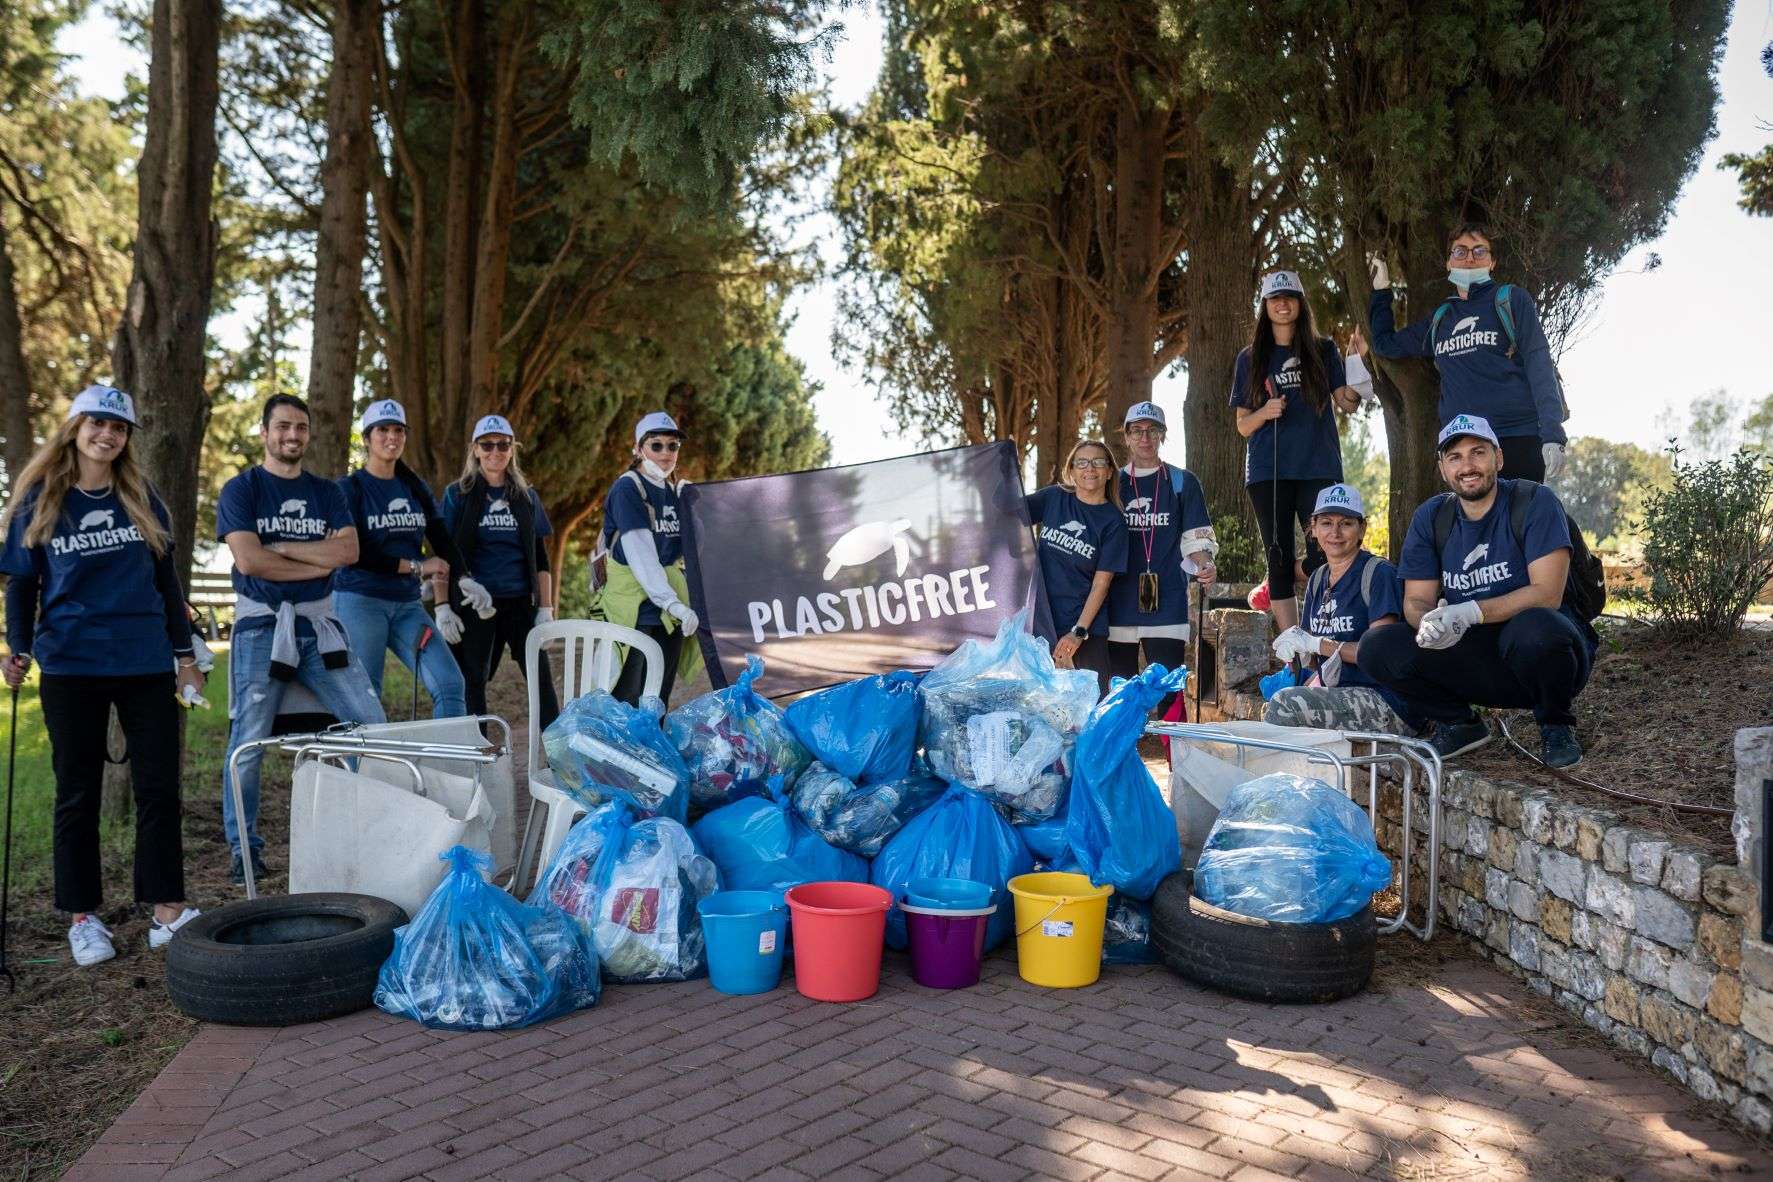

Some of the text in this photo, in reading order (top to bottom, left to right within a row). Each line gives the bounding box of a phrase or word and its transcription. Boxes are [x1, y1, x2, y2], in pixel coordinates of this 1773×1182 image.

[99, 399, 129, 414] KRUK
[1324, 495, 1351, 505] KRUK
[256, 516, 327, 536] PLASTICFREE
[748, 565, 996, 643] PLASTICFREE
